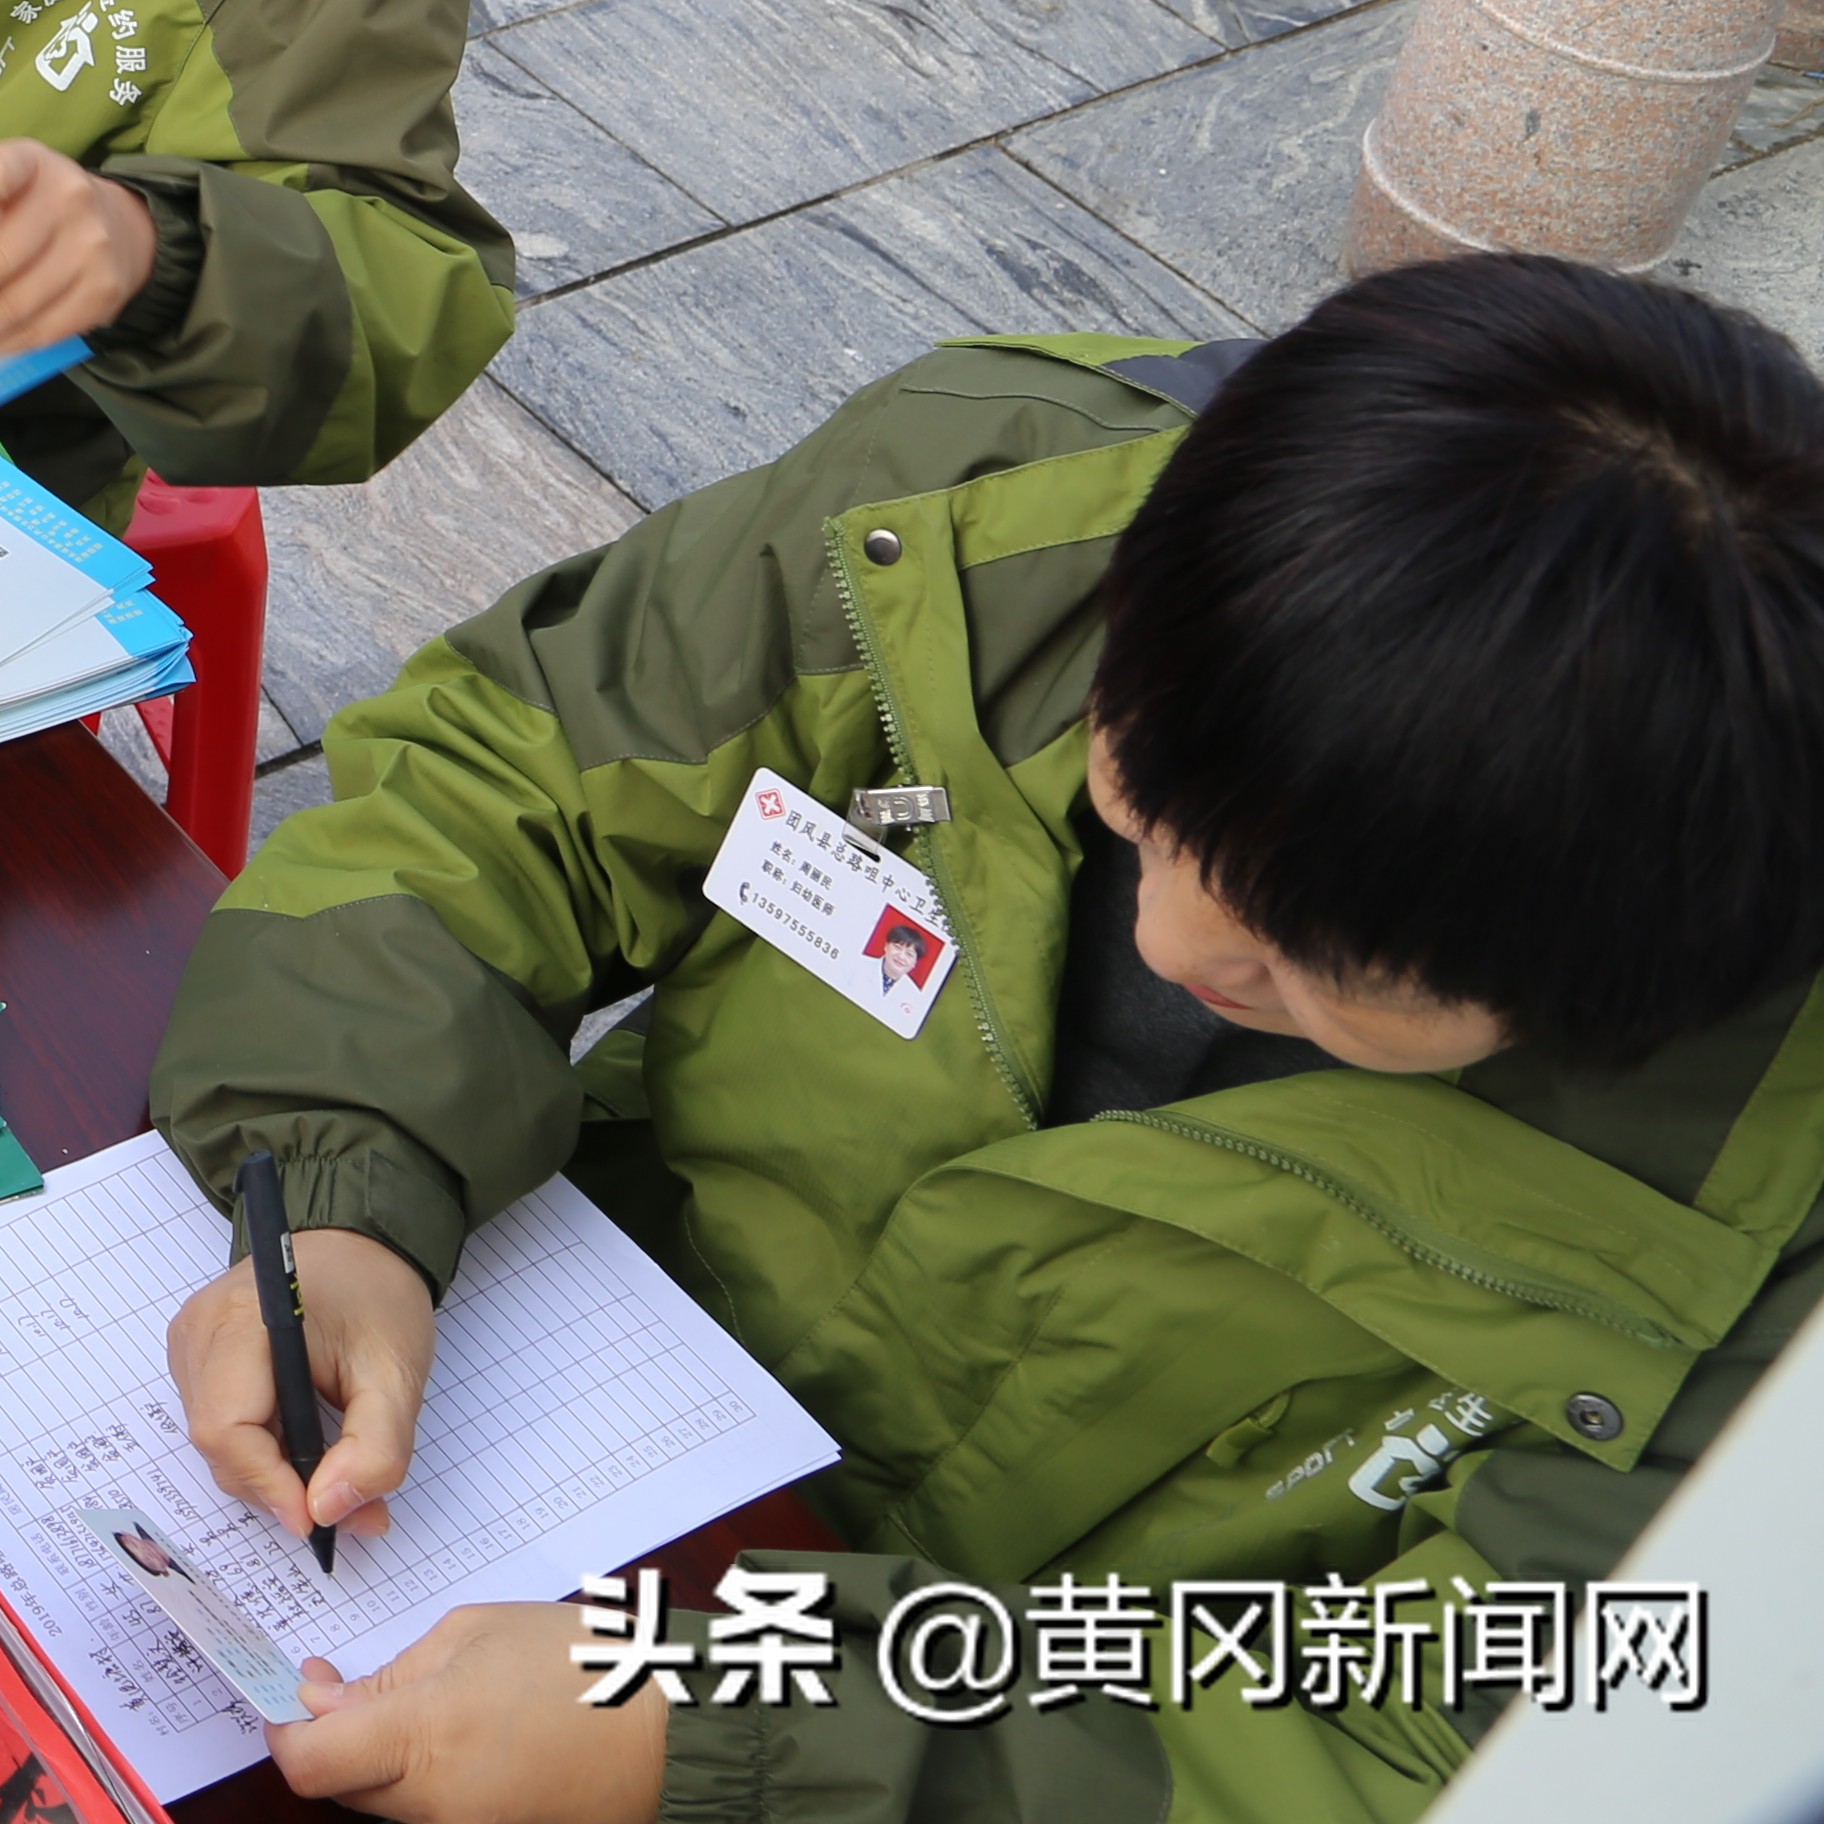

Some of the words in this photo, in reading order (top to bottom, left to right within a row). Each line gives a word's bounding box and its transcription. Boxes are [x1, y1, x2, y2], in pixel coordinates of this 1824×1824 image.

[749, 891, 840, 961] 13597555836
[29, 1531, 71, 1577] 联系电话
[74, 1586, 99, 1612] 性别
[98, 1616, 122, 1642] 年龄
[121, 1608, 144, 1629] 45
[129, 1658, 155, 1684] 姓名
[163, 1699, 189, 1726] 序号
